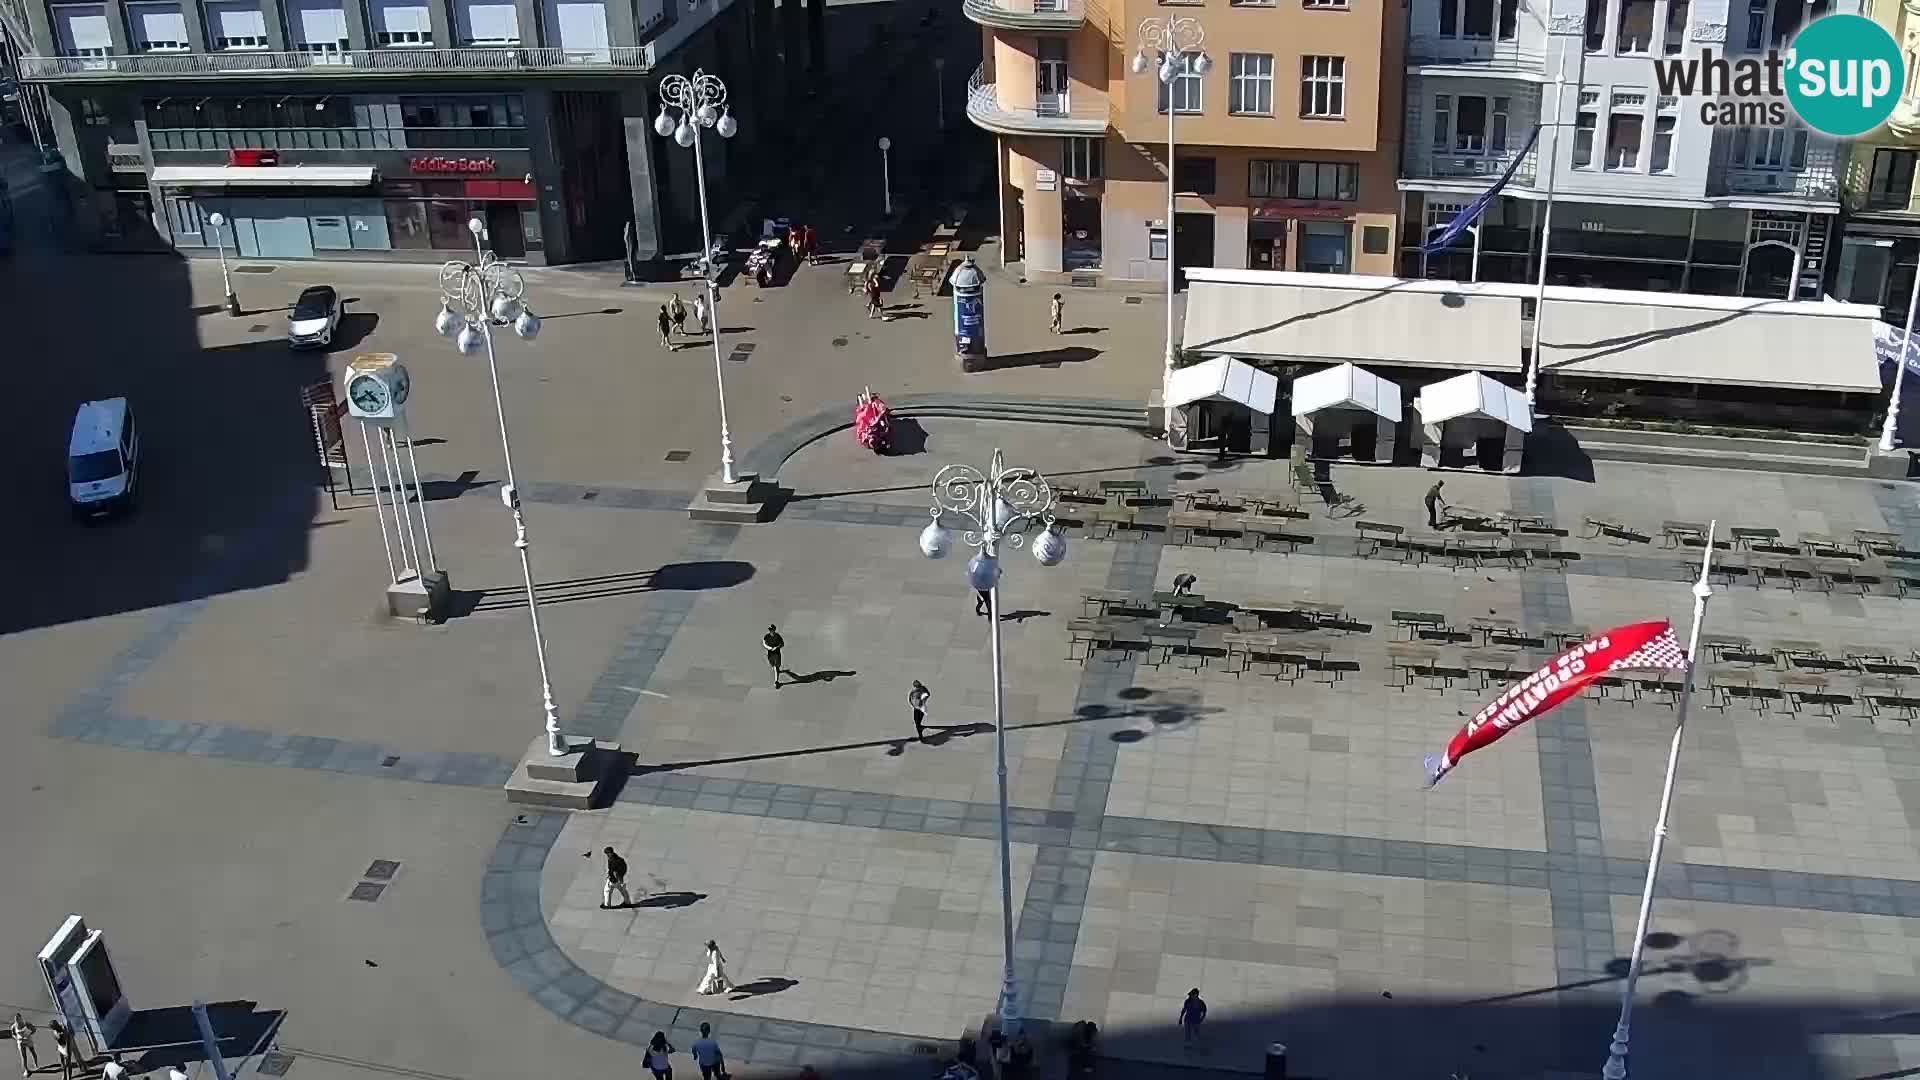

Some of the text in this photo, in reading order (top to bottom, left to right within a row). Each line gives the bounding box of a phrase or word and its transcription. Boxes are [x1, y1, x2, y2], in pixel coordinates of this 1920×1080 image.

[1467, 636, 1610, 737] FANS EMBASSY
[1493, 659, 1586, 729] CROATIAN
